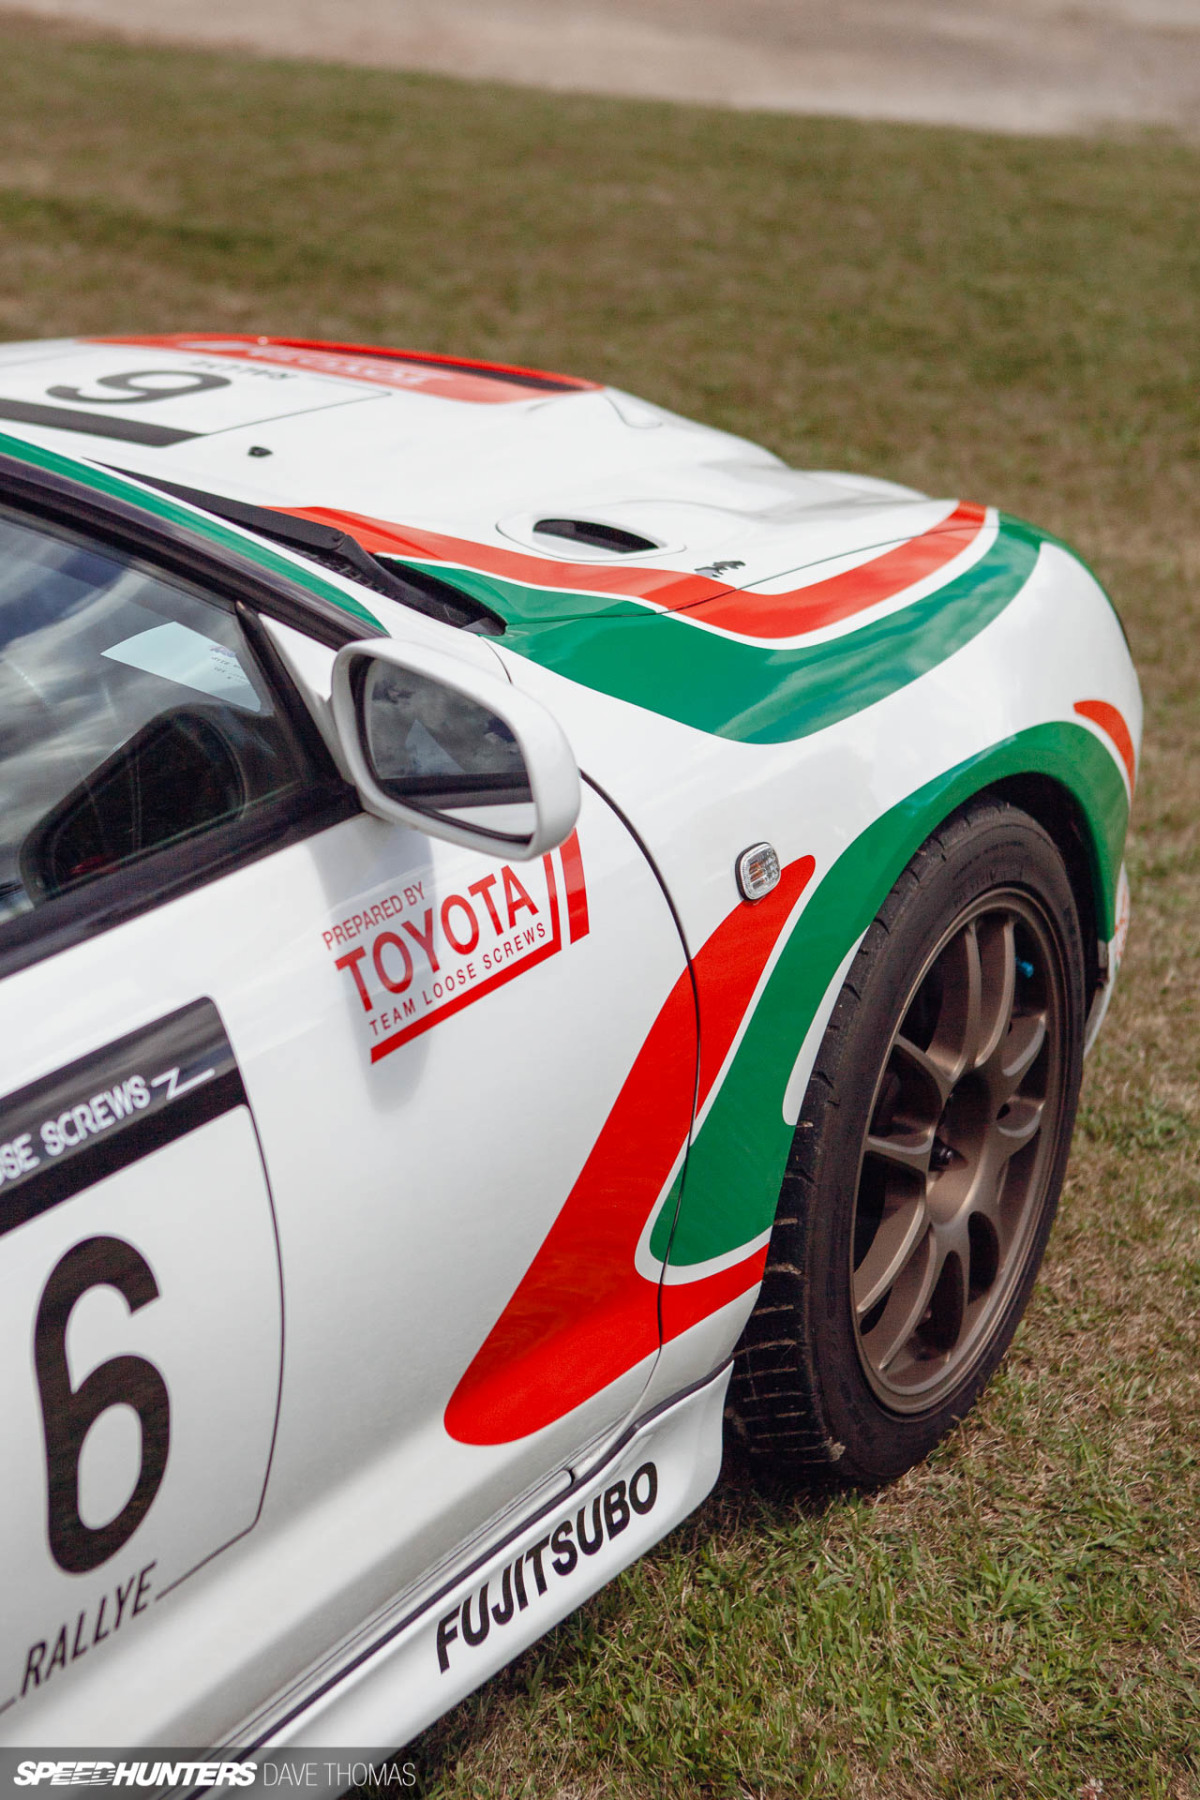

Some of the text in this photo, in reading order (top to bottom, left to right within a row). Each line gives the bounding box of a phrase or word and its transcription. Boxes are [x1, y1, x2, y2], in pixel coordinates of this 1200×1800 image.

[322, 881, 426, 950] PREPARED BY
[334, 865, 540, 1012] TOYOTA
[369, 922, 546, 1036] TEAM LOOSE SCREWS
[0, 1075, 151, 1186] SE SCREWS
[34, 1236, 170, 1574] 6
[21, 1561, 157, 1697] RALLYE
[436, 1461, 658, 1674] FUJITSUBO
